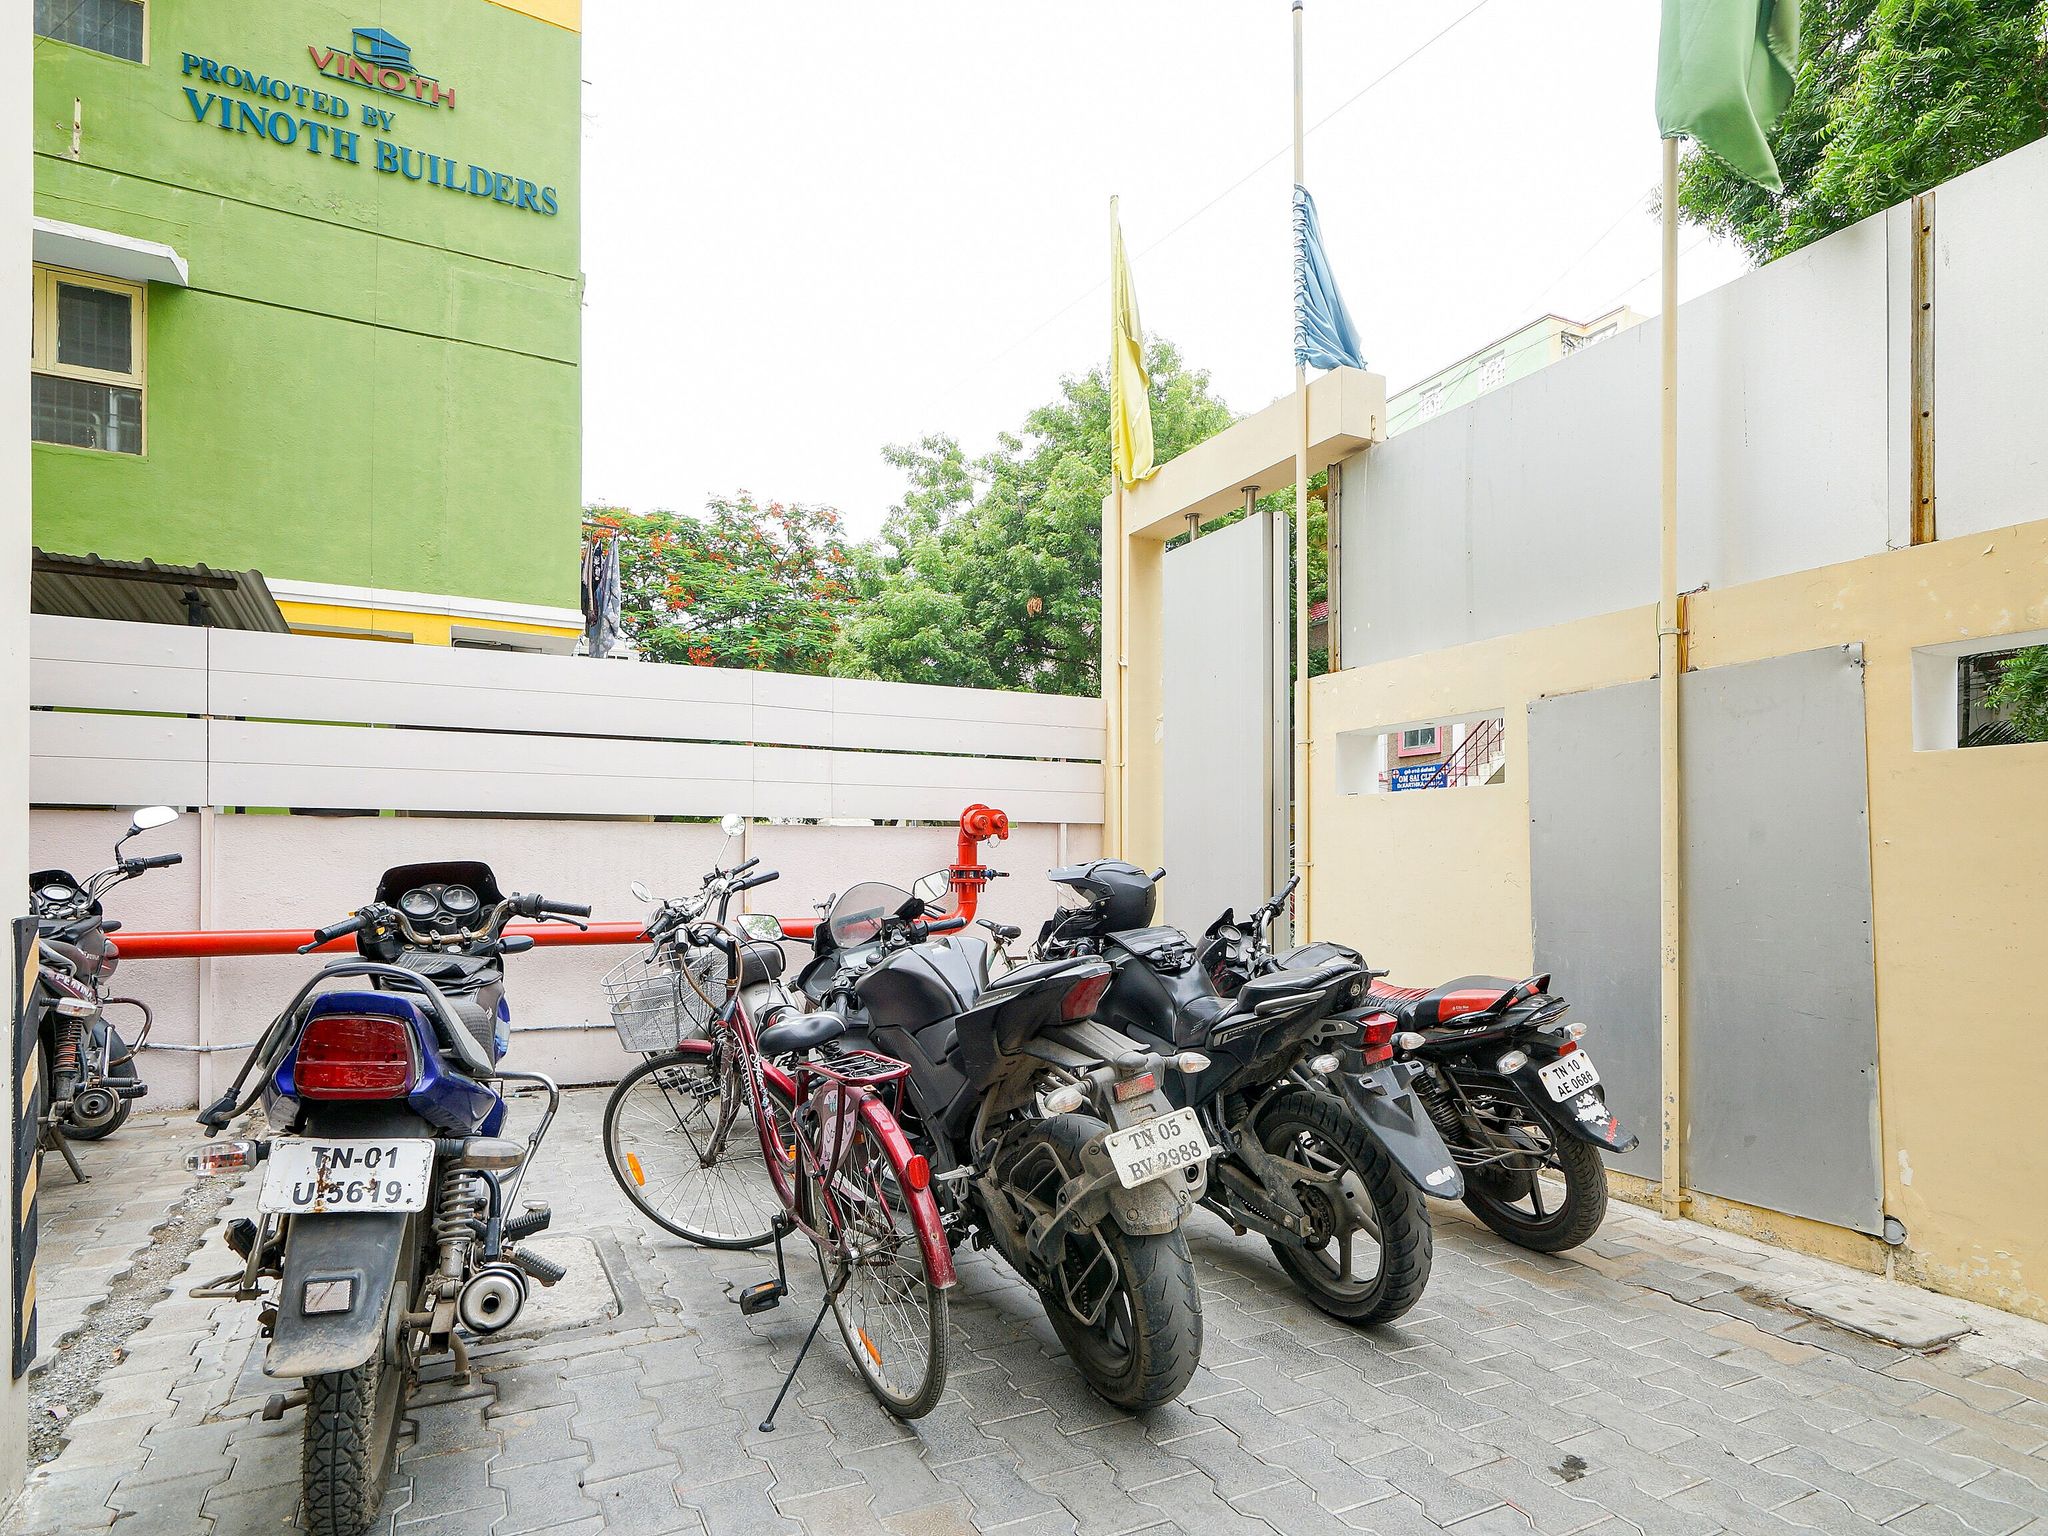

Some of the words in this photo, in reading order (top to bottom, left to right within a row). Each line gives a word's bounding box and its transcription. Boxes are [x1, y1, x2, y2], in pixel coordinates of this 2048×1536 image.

[308, 45, 456, 109] VINOTH
[181, 51, 350, 118] PROMOTED
[360, 104, 396, 132] BY
[182, 86, 360, 164] VINOTH
[374, 138, 559, 216] BUILDERS
[1398, 775, 1409, 783] OM
[1409, 774, 1420, 782] SAI
[1463, 1026, 1488, 1035] 150
[1552, 1065, 1569, 1080] TN
[1568, 1059, 1581, 1072] 10
[1557, 1082, 1573, 1097] AE
[1129, 1128, 1156, 1150] TN
[1158, 1118, 1181, 1140] 05
[311, 1147, 399, 1169] TN-01
[1128, 1157, 1153, 1181] BV
[1157, 1140, 1202, 1170] 2988
